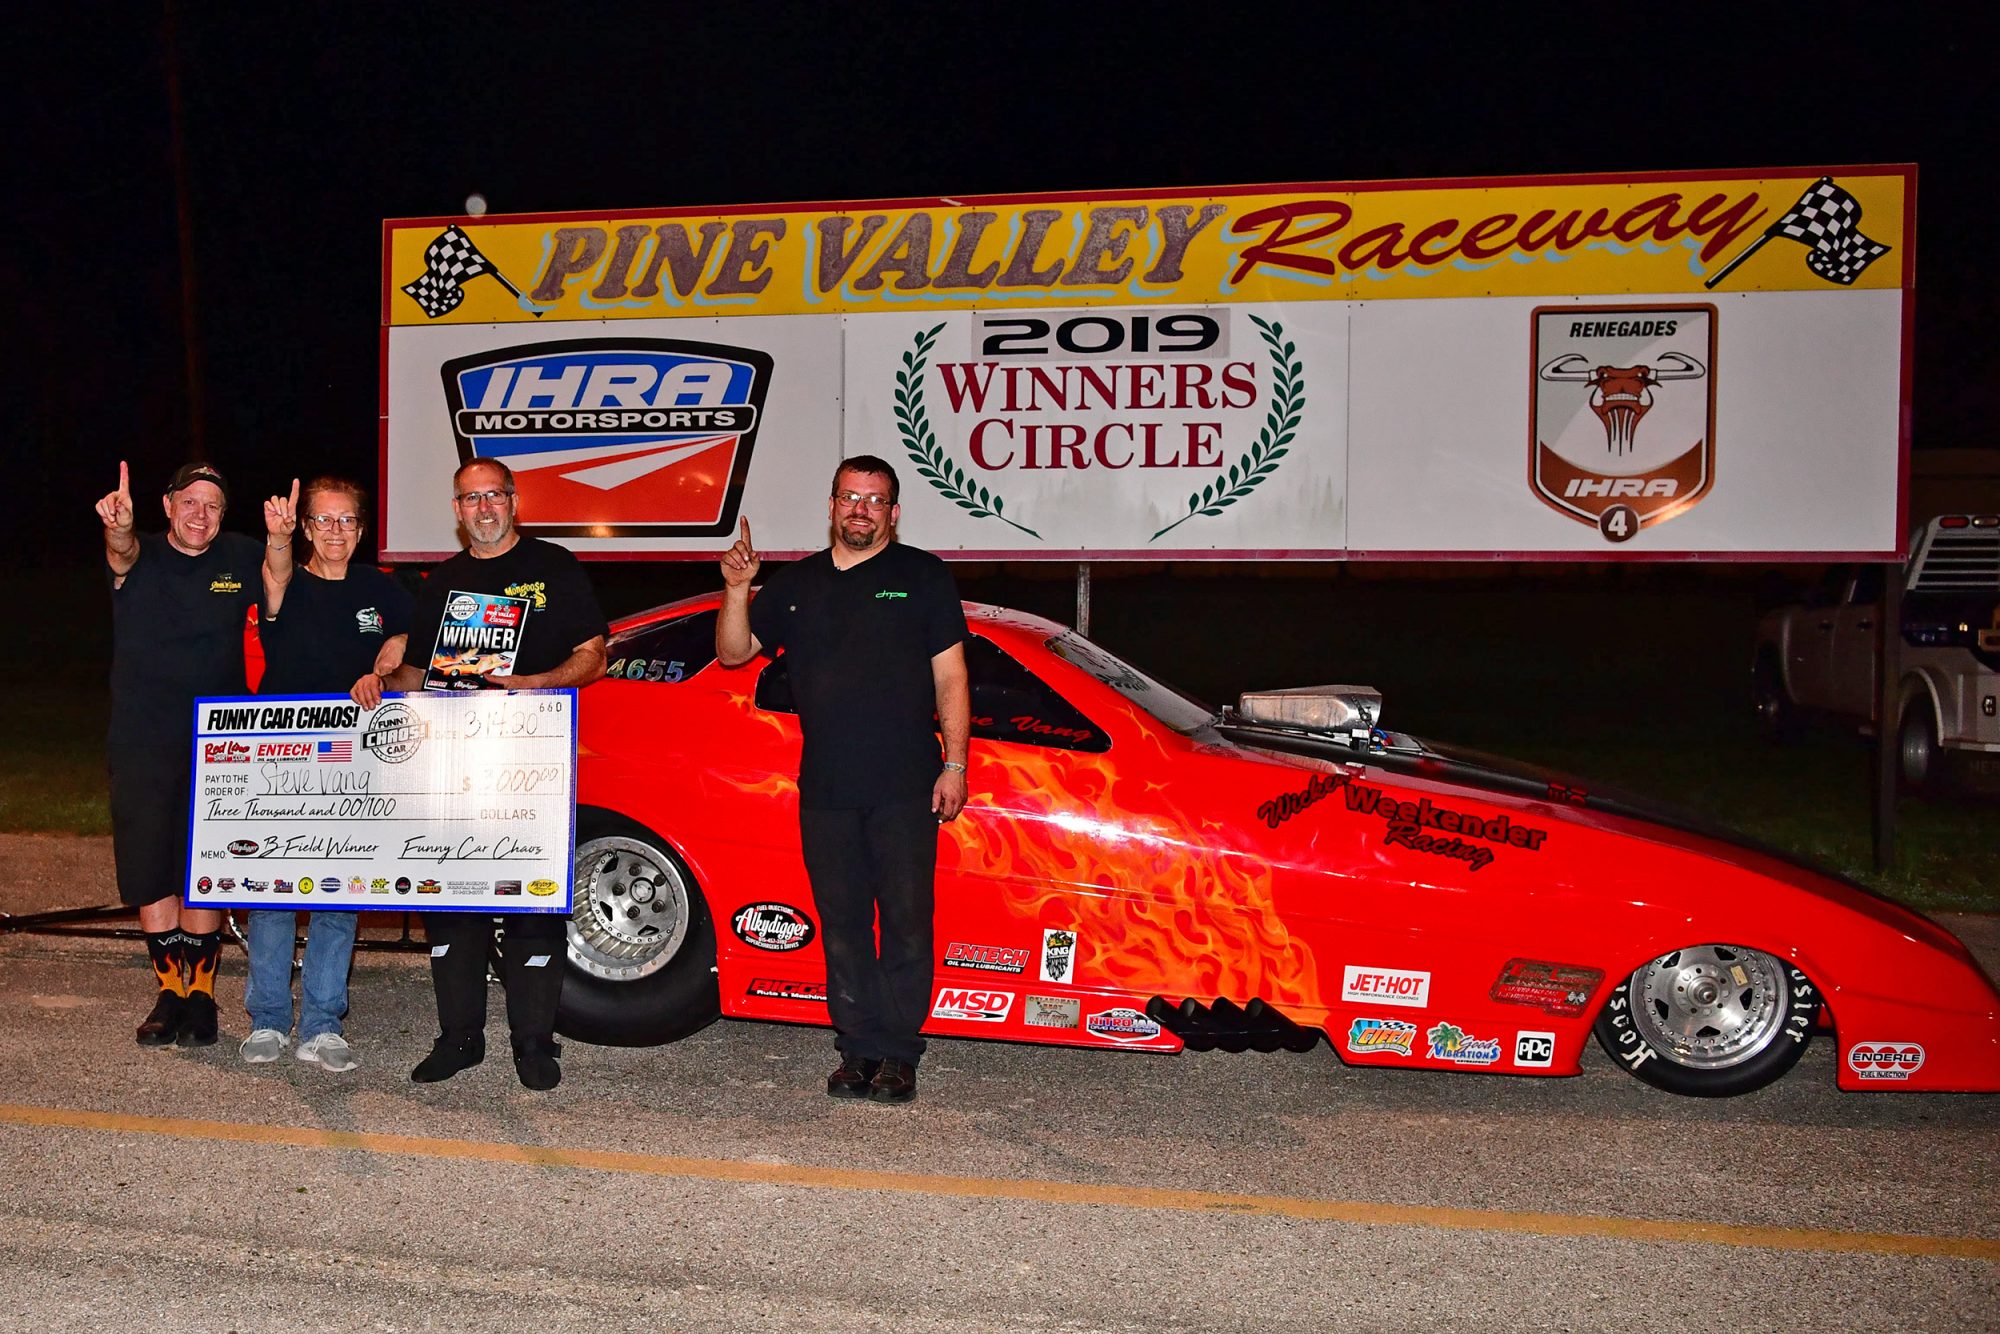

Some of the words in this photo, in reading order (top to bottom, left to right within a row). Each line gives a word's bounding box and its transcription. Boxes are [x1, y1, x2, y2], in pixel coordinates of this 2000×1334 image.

[531, 218, 786, 302] PINE
[816, 204, 1228, 293] VALLEY
[1230, 192, 1769, 285] Raceway
[981, 313, 1221, 356] 2019
[1568, 320, 1678, 339] RENEGADES
[476, 362, 734, 409] IHRA
[936, 360, 1258, 414] WINNERS
[474, 410, 737, 431] MOTORSPORTS
[968, 418, 1224, 472] CIRCLE
[1562, 477, 1680, 498] IHRA
[1607, 510, 1629, 537] 4
[442, 626, 516, 650] WINNER
[606, 658, 686, 684] 4655
[207, 707, 261, 731] FUNNY
[260, 706, 295, 730] CAR
[295, 705, 361, 730] CHAOS!
[378, 715, 410, 729] FUNNY
[1009, 716, 1094, 743] Vang
[205, 741, 227, 758] Red
[256, 742, 313, 757] ENTECH
[386, 744, 406, 755] CAR
[205, 775, 220, 784] PAY
[221, 775, 232, 784] TO
[233, 774, 249, 784] THE
[260, 761, 315, 795] Steve
[319, 766, 371, 802] Vang
[205, 787, 232, 796] ORDER
[207, 798, 241, 820] Three
[244, 798, 306, 820] Thousand
[308, 802, 337, 817] and
[338, 797, 397, 819] 00/100
[480, 808, 537, 821] DOLLARS
[1343, 783, 1548, 852] Weekender
[200, 850, 229, 860] MEMO:
[283, 834, 326, 857] Field
[325, 833, 380, 859] Winner
[401, 835, 457, 864] Funny
[456, 836, 490, 859] Car
[492, 836, 544, 859] Chaos
[1383, 818, 1495, 872] Racing
[735, 907, 810, 940] Alkydigger
[157, 933, 203, 947] VANS
[945, 942, 1031, 967] ENTECH
[1049, 946, 1069, 956] KING
[975, 962, 1021, 973] LUBRICANTS
[756, 989, 779, 997] Auto
[1349, 973, 1424, 995] JET-HOT
[937, 989, 1009, 1013] MSD
[1433, 1043, 1500, 1061] VIBRATIONS
[1458, 1036, 1498, 1053] Good
[1518, 1039, 1551, 1060] PPG
[1852, 1053, 1921, 1062] ENDERLE
[1860, 1070, 1876, 1079] FUEL
[1876, 1070, 1907, 1079] INJECTION
